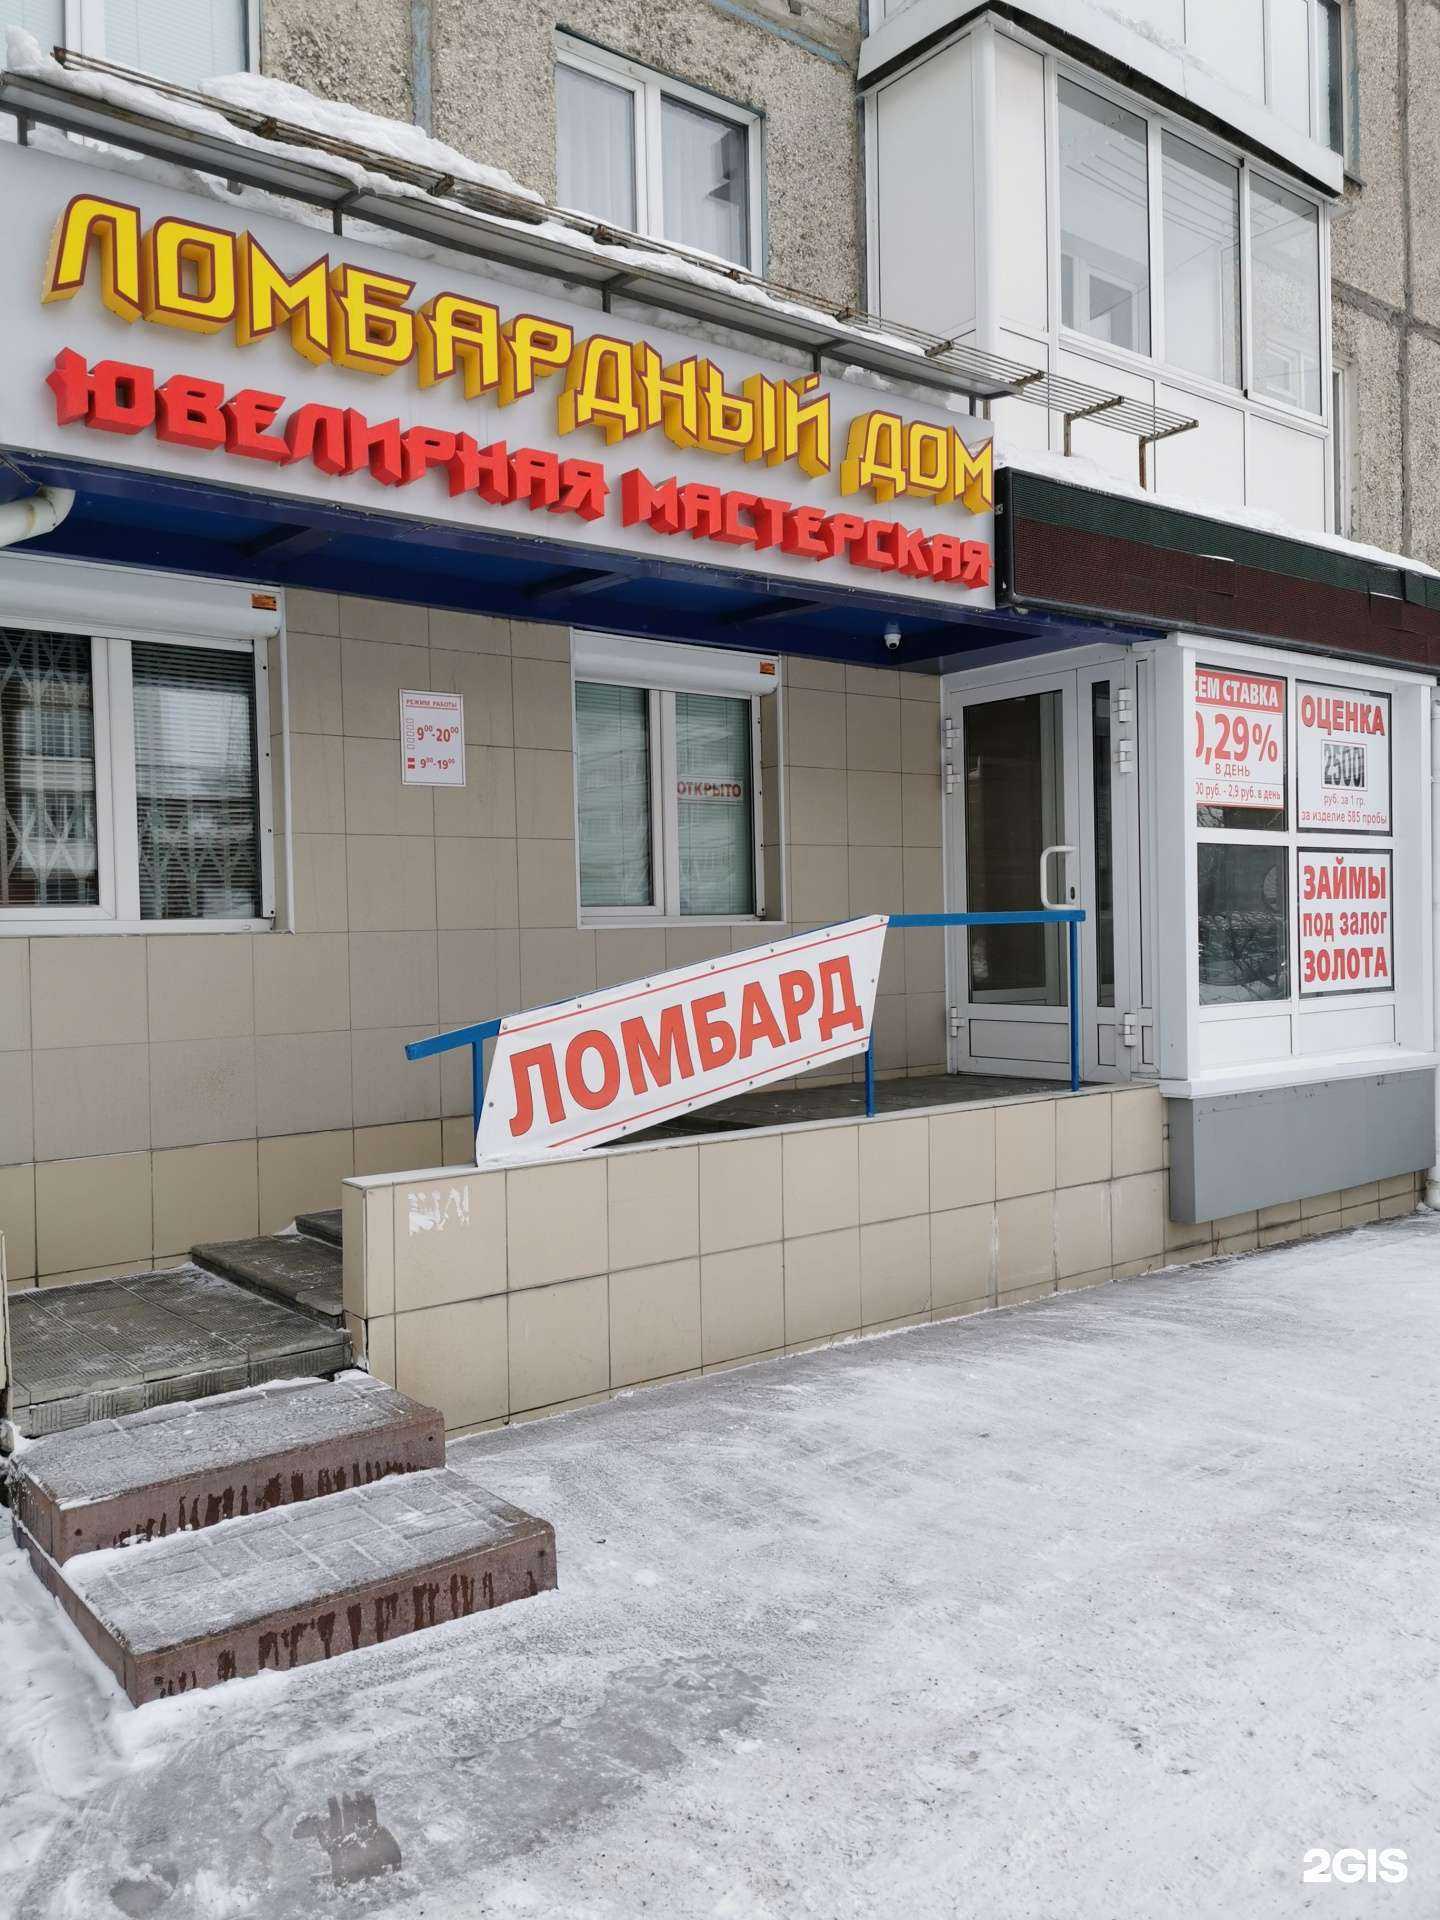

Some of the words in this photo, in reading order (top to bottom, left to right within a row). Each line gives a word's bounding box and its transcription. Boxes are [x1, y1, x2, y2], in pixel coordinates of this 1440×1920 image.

[43, 193, 832, 478] ЛОМБАРДНЫЙ
[841, 408, 994, 514] ДОМ
[45, 346, 609, 521] ЮВЕЛИРНАЯ
[621, 466, 993, 589] МАСТЕРСКАЯ
[1222, 679, 1279, 708] СТАВКА
[1301, 694, 1386, 736] ОЦЕНКА
[1224, 763, 1250, 777] ДЕНЬ
[677, 781, 742, 798] ОТКРЫТО
[1312, 811, 1346, 824] изделие
[1362, 812, 1388, 825] пробы
[1303, 856, 1387, 900] ЗАЙМЫ
[1303, 912, 1335, 942] под
[1339, 911, 1388, 936] залог
[1303, 947, 1388, 983] ЗОЛОТА
[508, 955, 864, 1138] ЛОМБАРД
